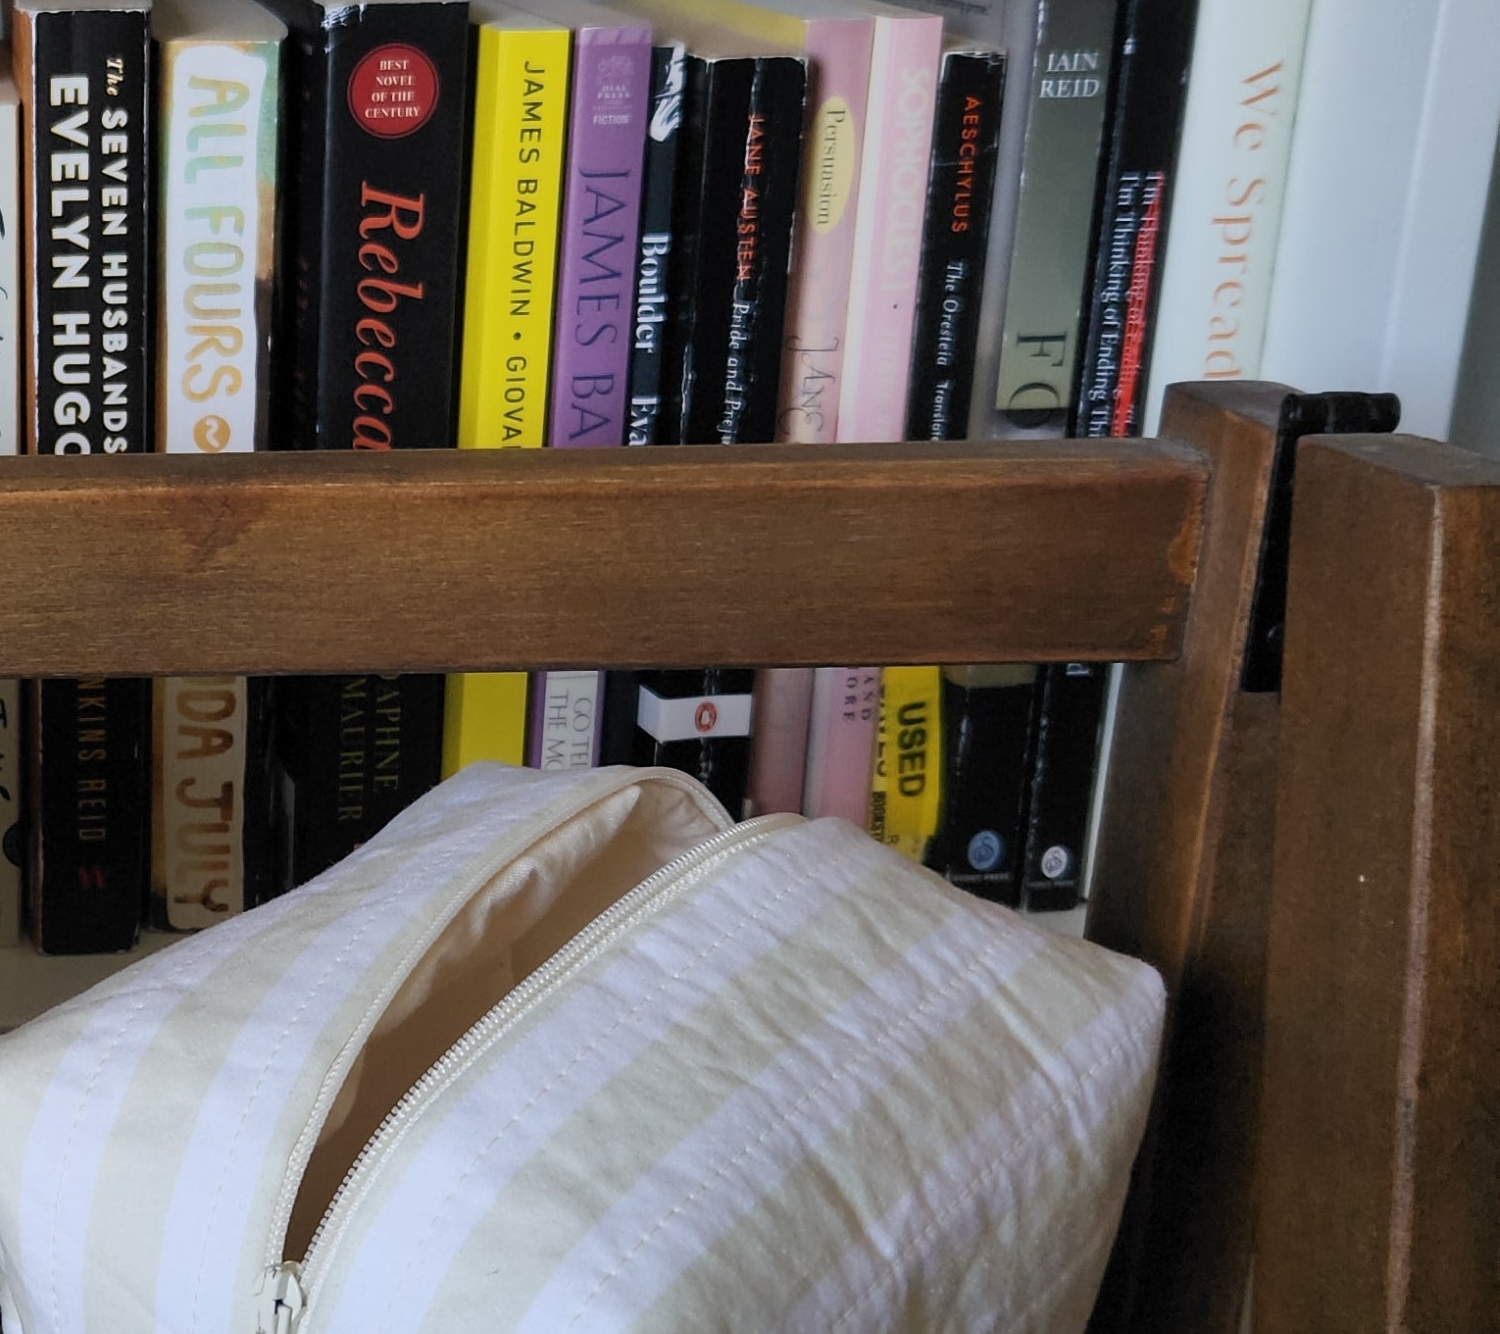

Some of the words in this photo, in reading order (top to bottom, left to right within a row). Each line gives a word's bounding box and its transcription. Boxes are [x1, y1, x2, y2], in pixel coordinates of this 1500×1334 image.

[105, 58, 125, 97] The
[371, 91, 389, 103] OF
[390, 90, 416, 103] THE
[375, 74, 417, 87] NOVEL
[379, 59, 410, 71] BEST
[1039, 79, 1100, 100] REID
[1044, 52, 1100, 72] IAIN
[182, 74, 250, 186] ALL
[364, 106, 422, 120] CENTURY
[518, 60, 546, 165] JAMES
[743, 113, 765, 176] JANE
[1229, 60, 1283, 153] We
[49, 75, 91, 289] EVELYN
[101, 109, 128, 236] SEVEN
[815, 108, 847, 226] Persuasion
[950, 95, 983, 234] AESCHYLUS
[1118, 171, 1140, 207] I'm
[509, 179, 539, 318] BALDWIN
[574, 167, 629, 349] JAMES
[736, 188, 760, 281] AUSTEN
[944, 261, 964, 293] The
[1101, 212, 1137, 303] Thinking
[1203, 176, 1266, 379] Spread
[180, 205, 246, 405] FOURS
[352, 179, 426, 451] Rebecca
[634, 232, 671, 356] Boulder
[729, 301, 751, 350] Pride
[936, 299, 960, 366] Oresteia
[1100, 307, 1120, 327] of
[102, 254, 128, 453] HUSBANDS
[725, 357, 746, 391] and
[1092, 331, 1119, 400] Ending
[500, 354, 528, 449] GIOVA
[567, 373, 615, 441] BA
[174, 676, 237, 762] DA
[372, 674, 401, 793] APHNE
[547, 690, 570, 731] THE
[572, 697, 593, 732] GO
[843, 667, 859, 722] ORE
[337, 677, 365, 823] MAURIER
[897, 701, 928, 798] USED
[77, 777, 108, 843] REID
[173, 777, 235, 914] JULY
